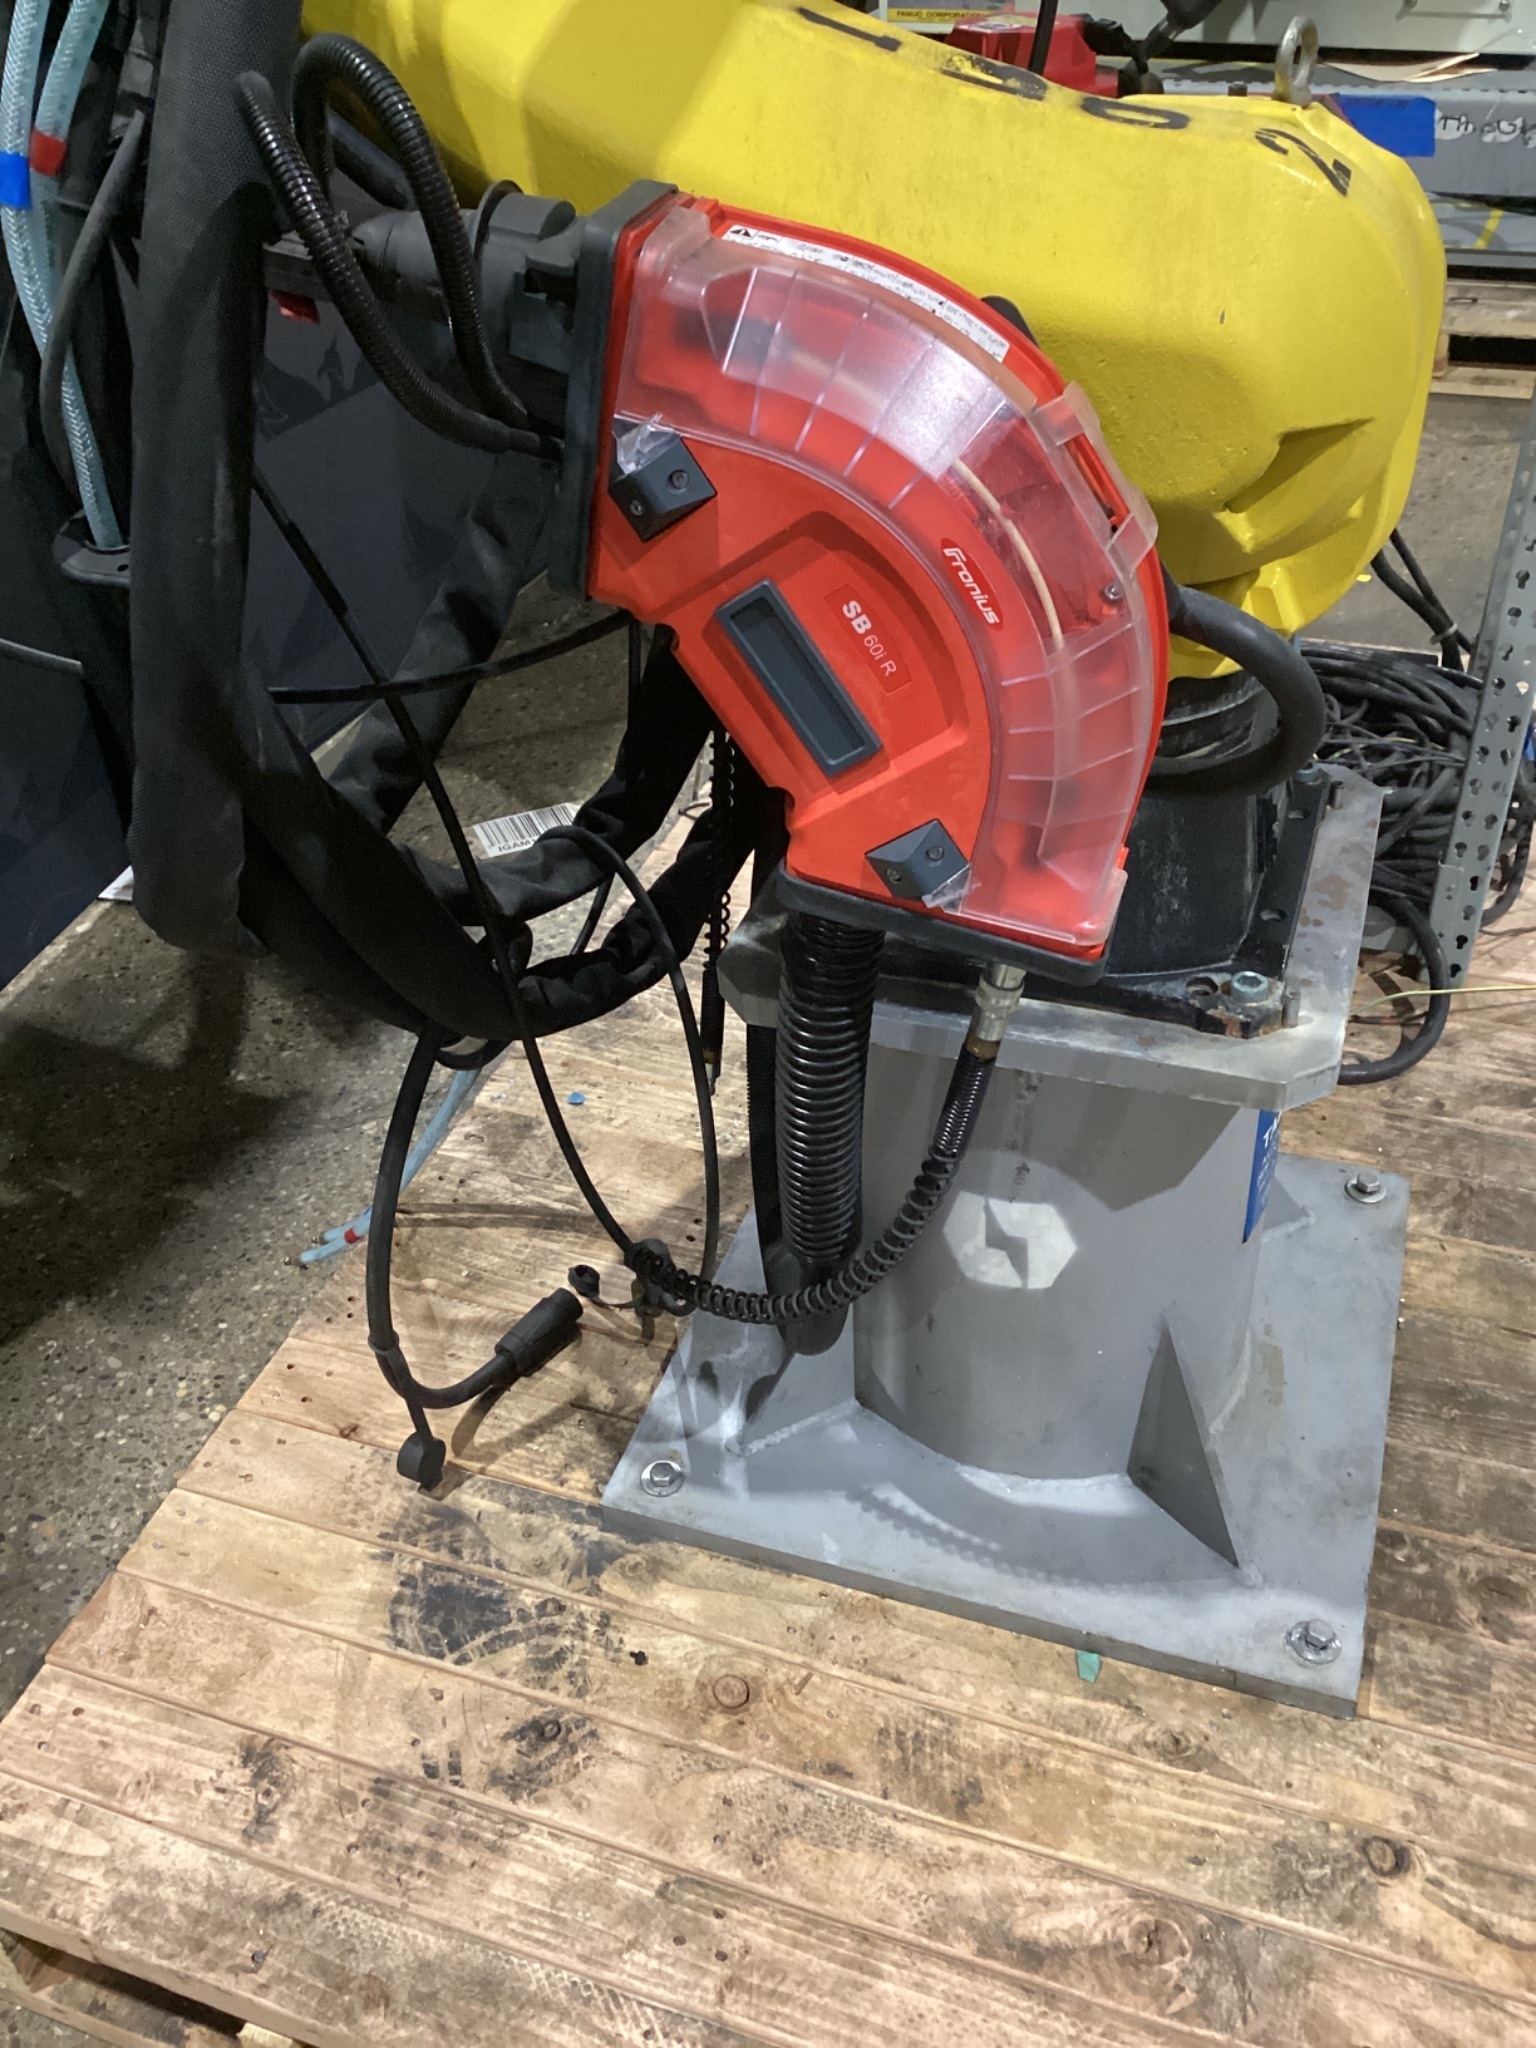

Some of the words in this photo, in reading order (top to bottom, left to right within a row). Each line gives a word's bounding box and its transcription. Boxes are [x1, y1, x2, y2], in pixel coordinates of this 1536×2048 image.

[942, 547, 1001, 624] Fronius
[842, 600, 872, 634] SB
[864, 634, 887, 660] 60i
[880, 660, 897, 677] R
[498, 838, 535, 852] IGAM
